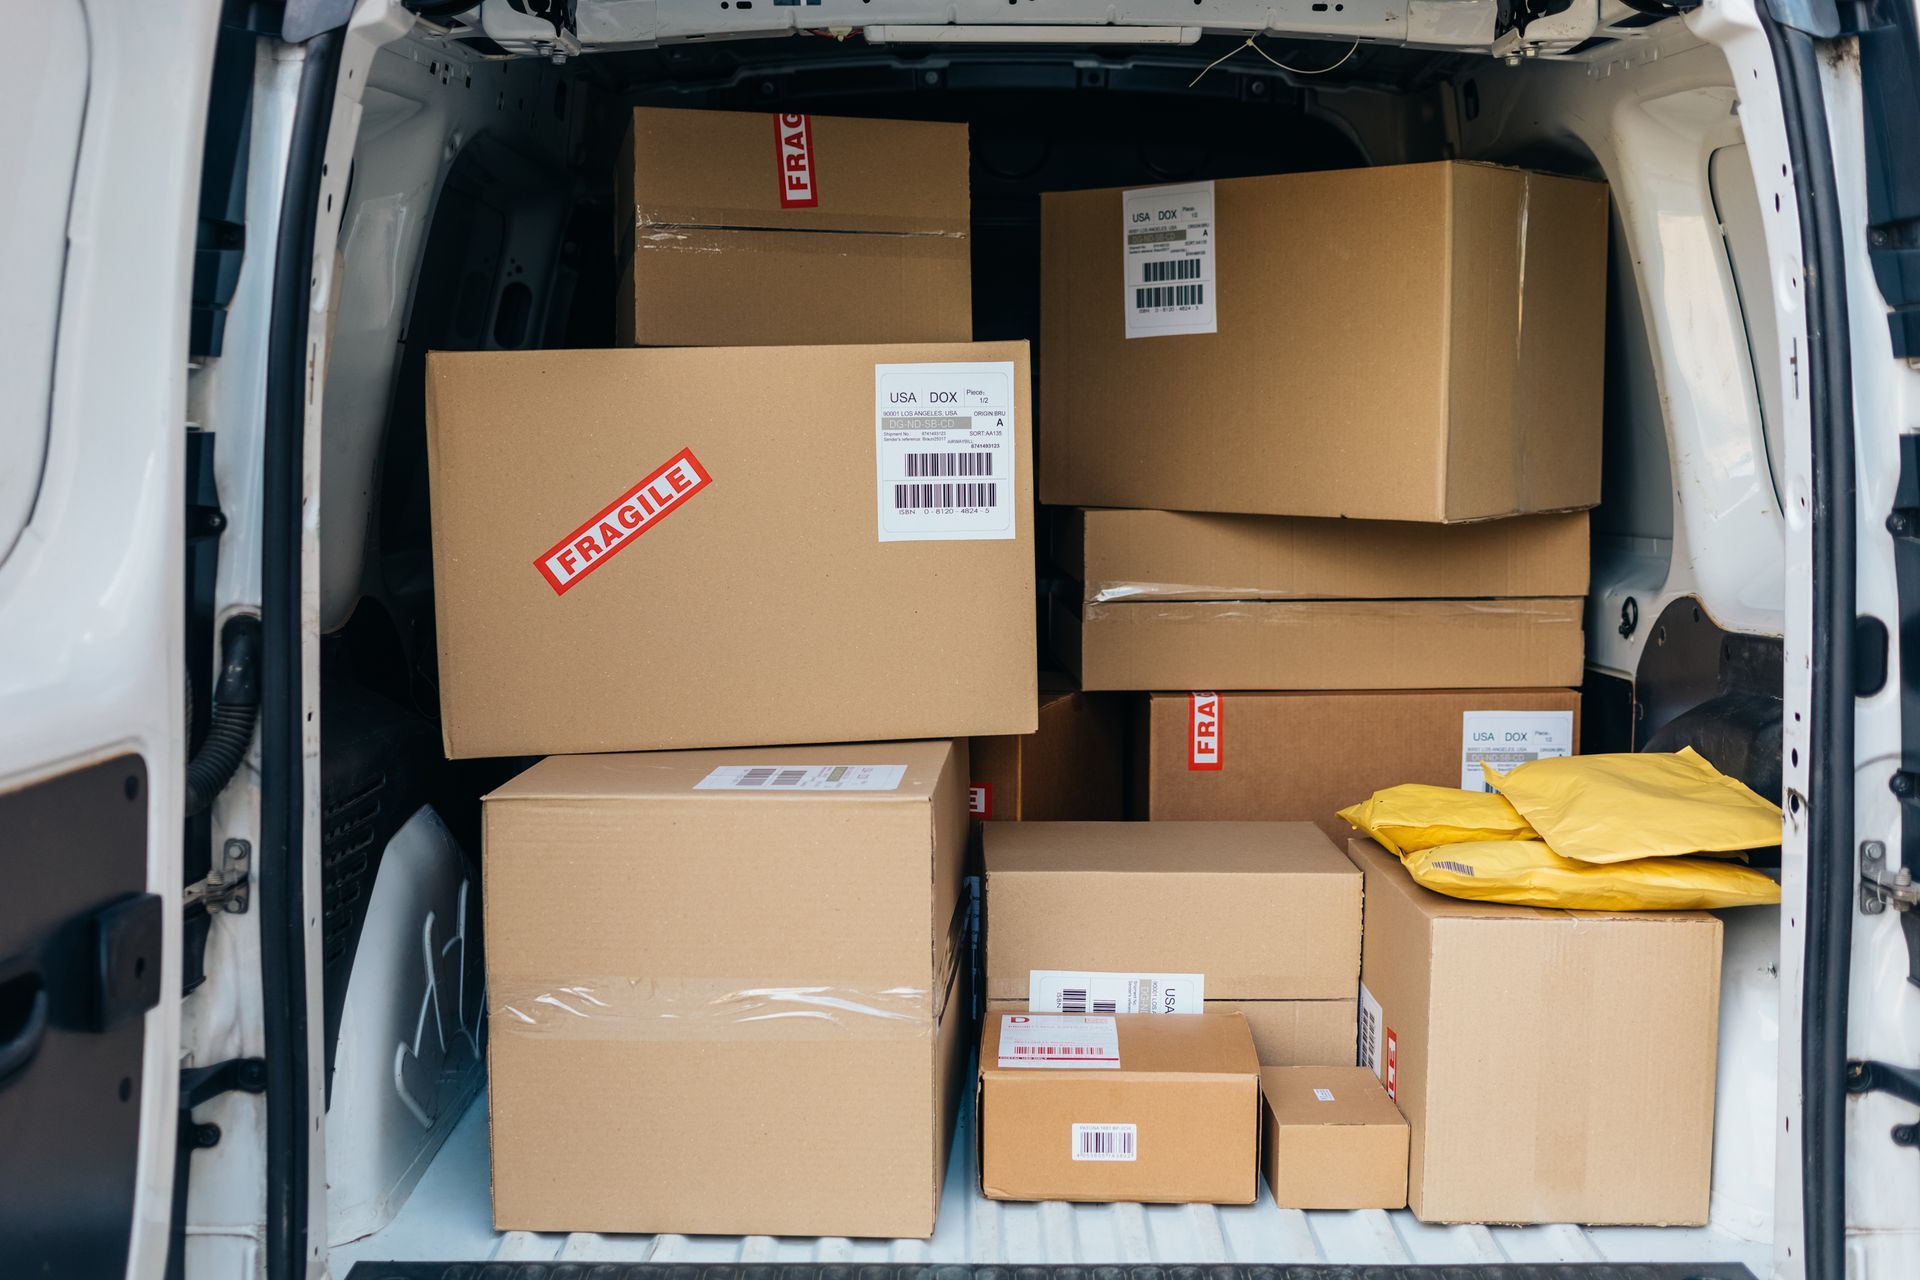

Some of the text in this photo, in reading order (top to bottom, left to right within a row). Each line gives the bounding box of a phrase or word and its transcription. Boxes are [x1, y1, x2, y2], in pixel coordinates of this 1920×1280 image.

[1132, 209, 1177, 223] USA DOX
[890, 392, 958, 404] USA DOX
[890, 419, 954, 428] DG-ND-SB-CD
[996, 418, 1004, 426] A
[557, 466, 692, 576] FRAGILE
[1197, 692, 1216, 754] FRA
[1473, 732, 1528, 742] USA DOX
[1165, 988, 1176, 1014] USA
